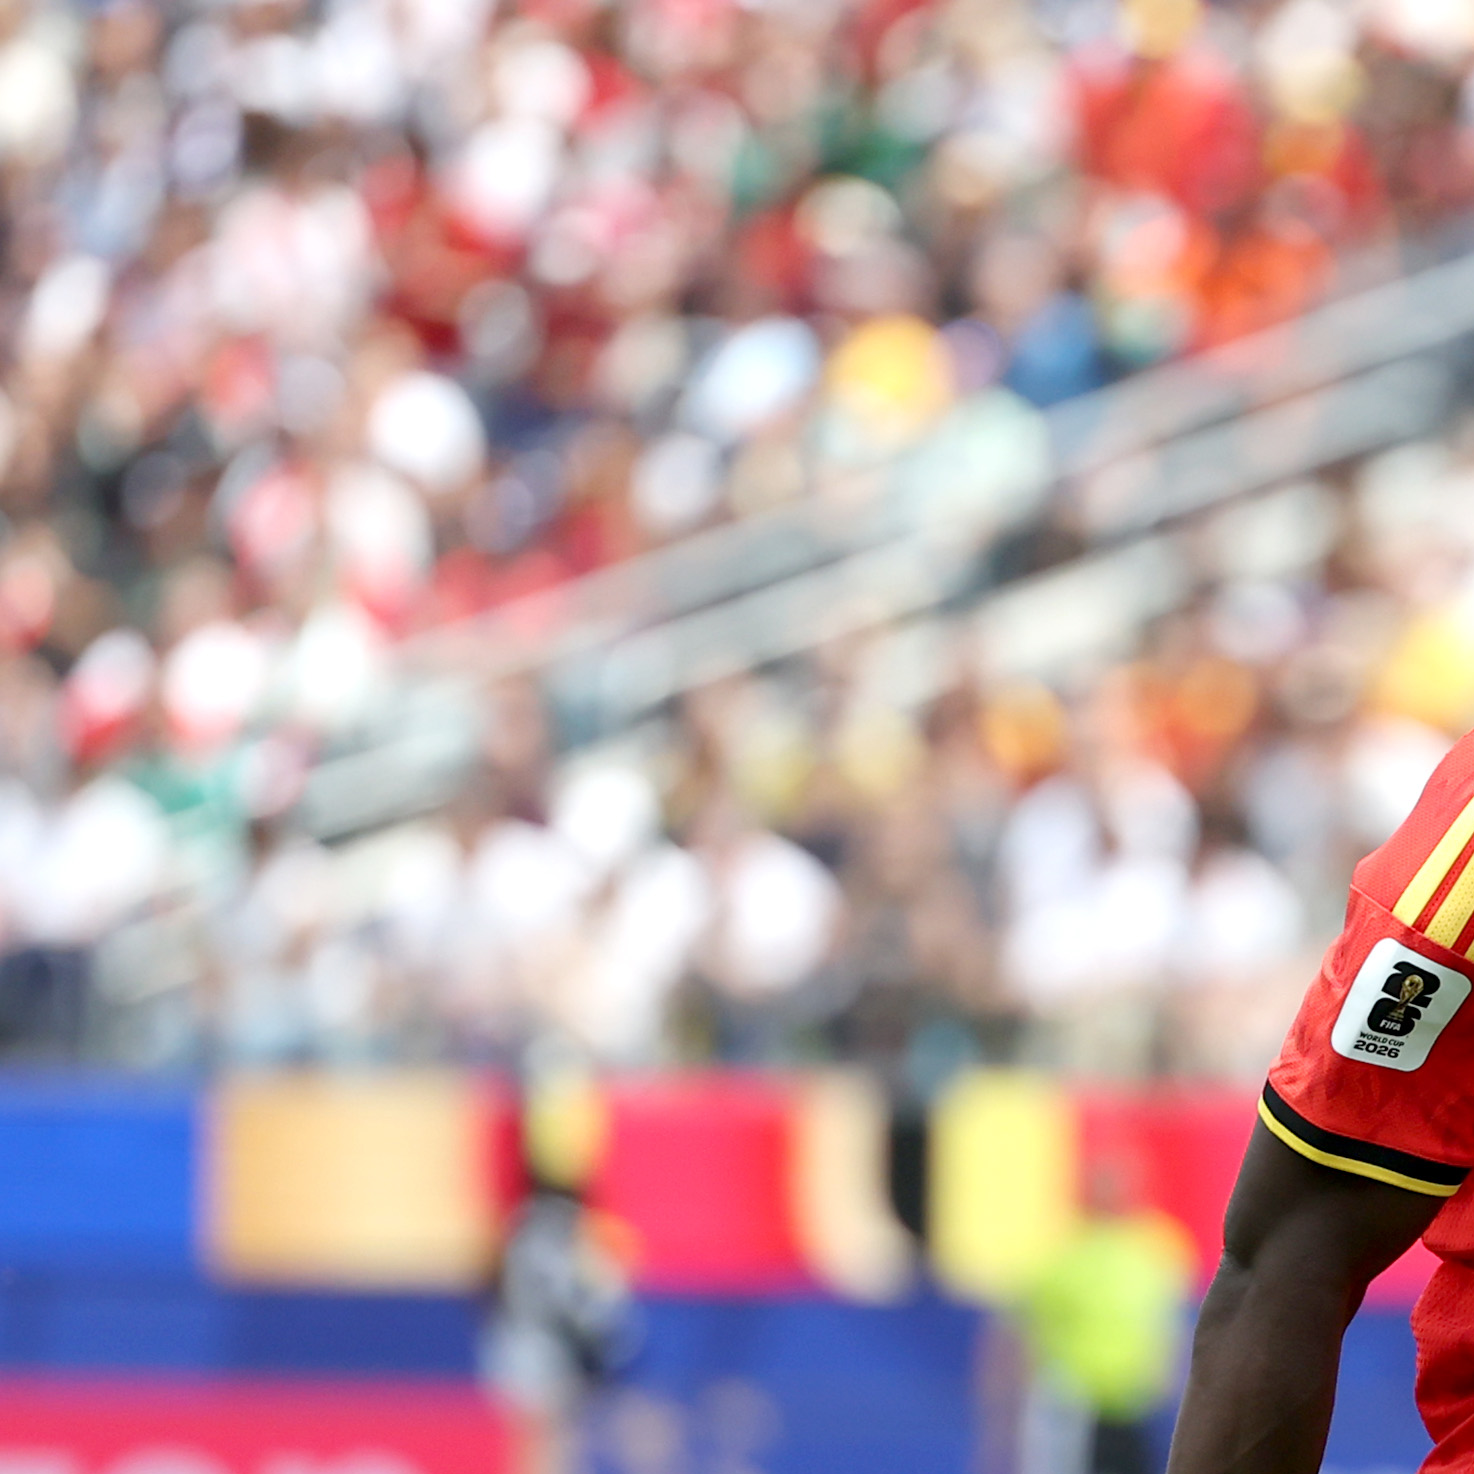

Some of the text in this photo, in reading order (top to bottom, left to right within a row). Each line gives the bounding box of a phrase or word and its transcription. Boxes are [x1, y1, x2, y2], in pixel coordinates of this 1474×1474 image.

[1379, 1019, 1402, 1031] FIFA
[1359, 1031, 1405, 1048] WORLD CUP
[1353, 1040, 1400, 1059] 2026
